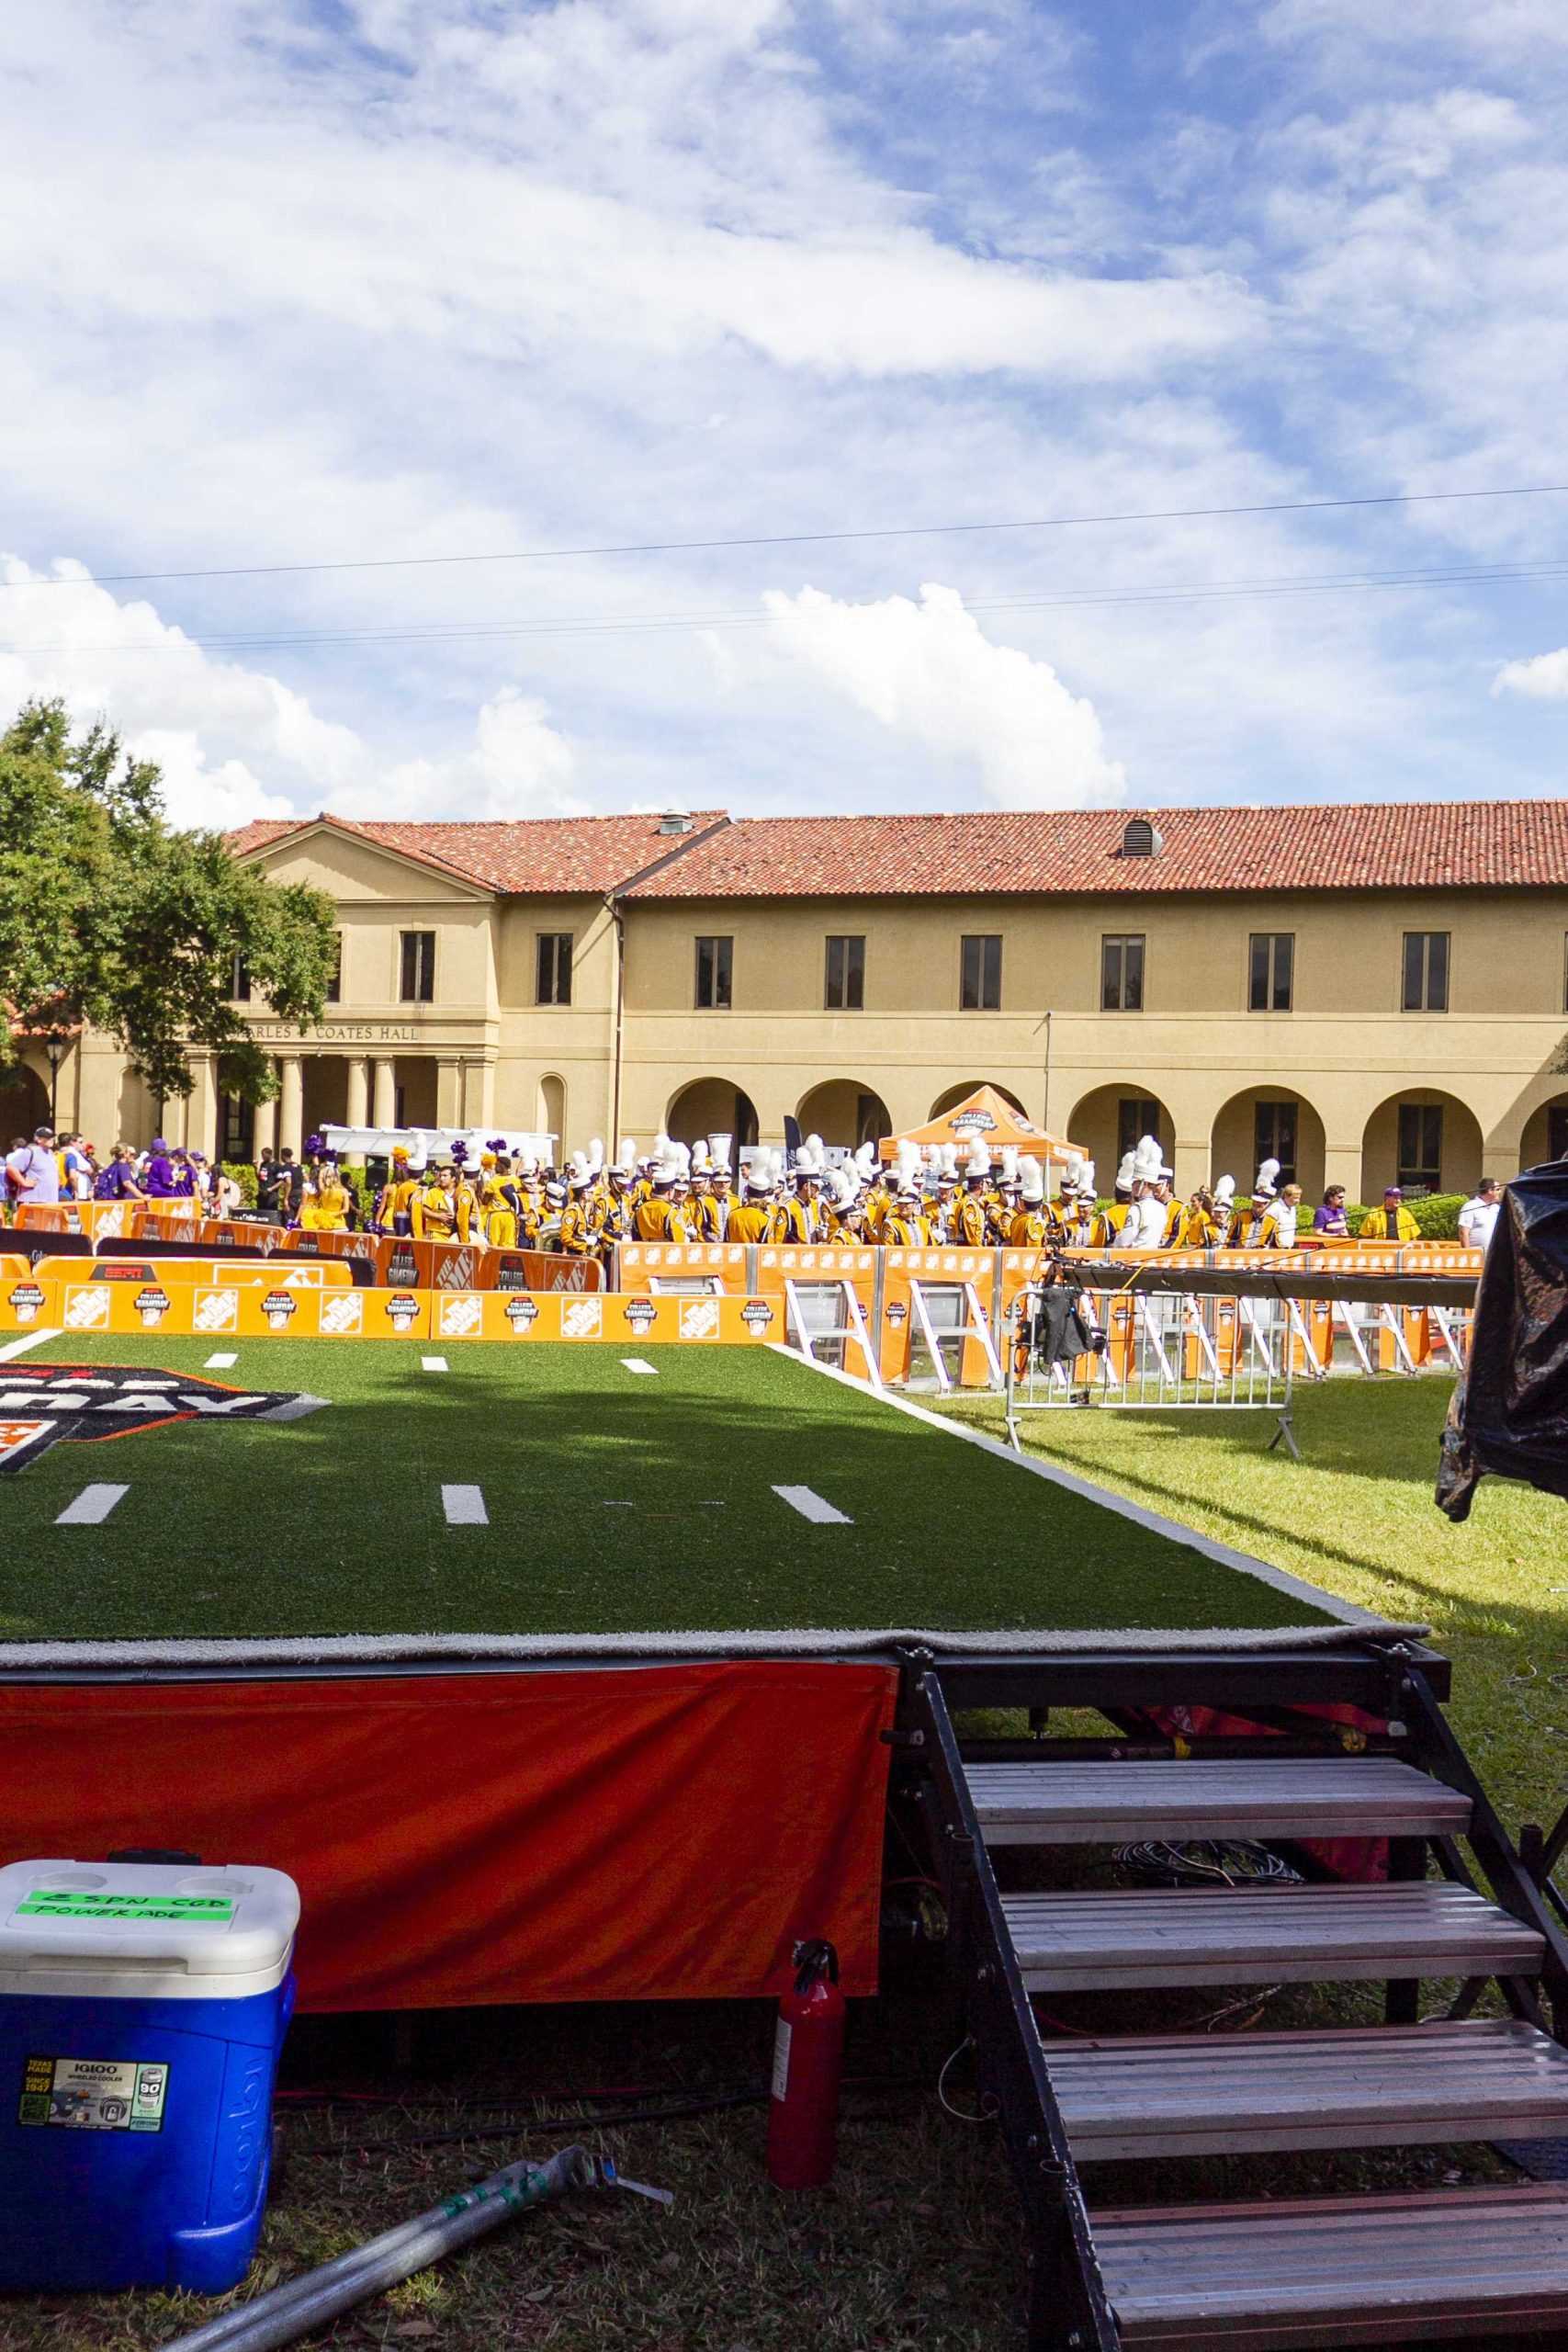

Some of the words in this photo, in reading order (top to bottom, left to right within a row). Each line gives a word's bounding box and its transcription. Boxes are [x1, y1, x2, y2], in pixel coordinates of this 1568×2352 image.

[229, 1026, 291, 1038] ARLES
[316, 1026, 372, 1039] COATES
[380, 1027, 420, 1040] HALL
[141, 2083, 161, 2094] 90
